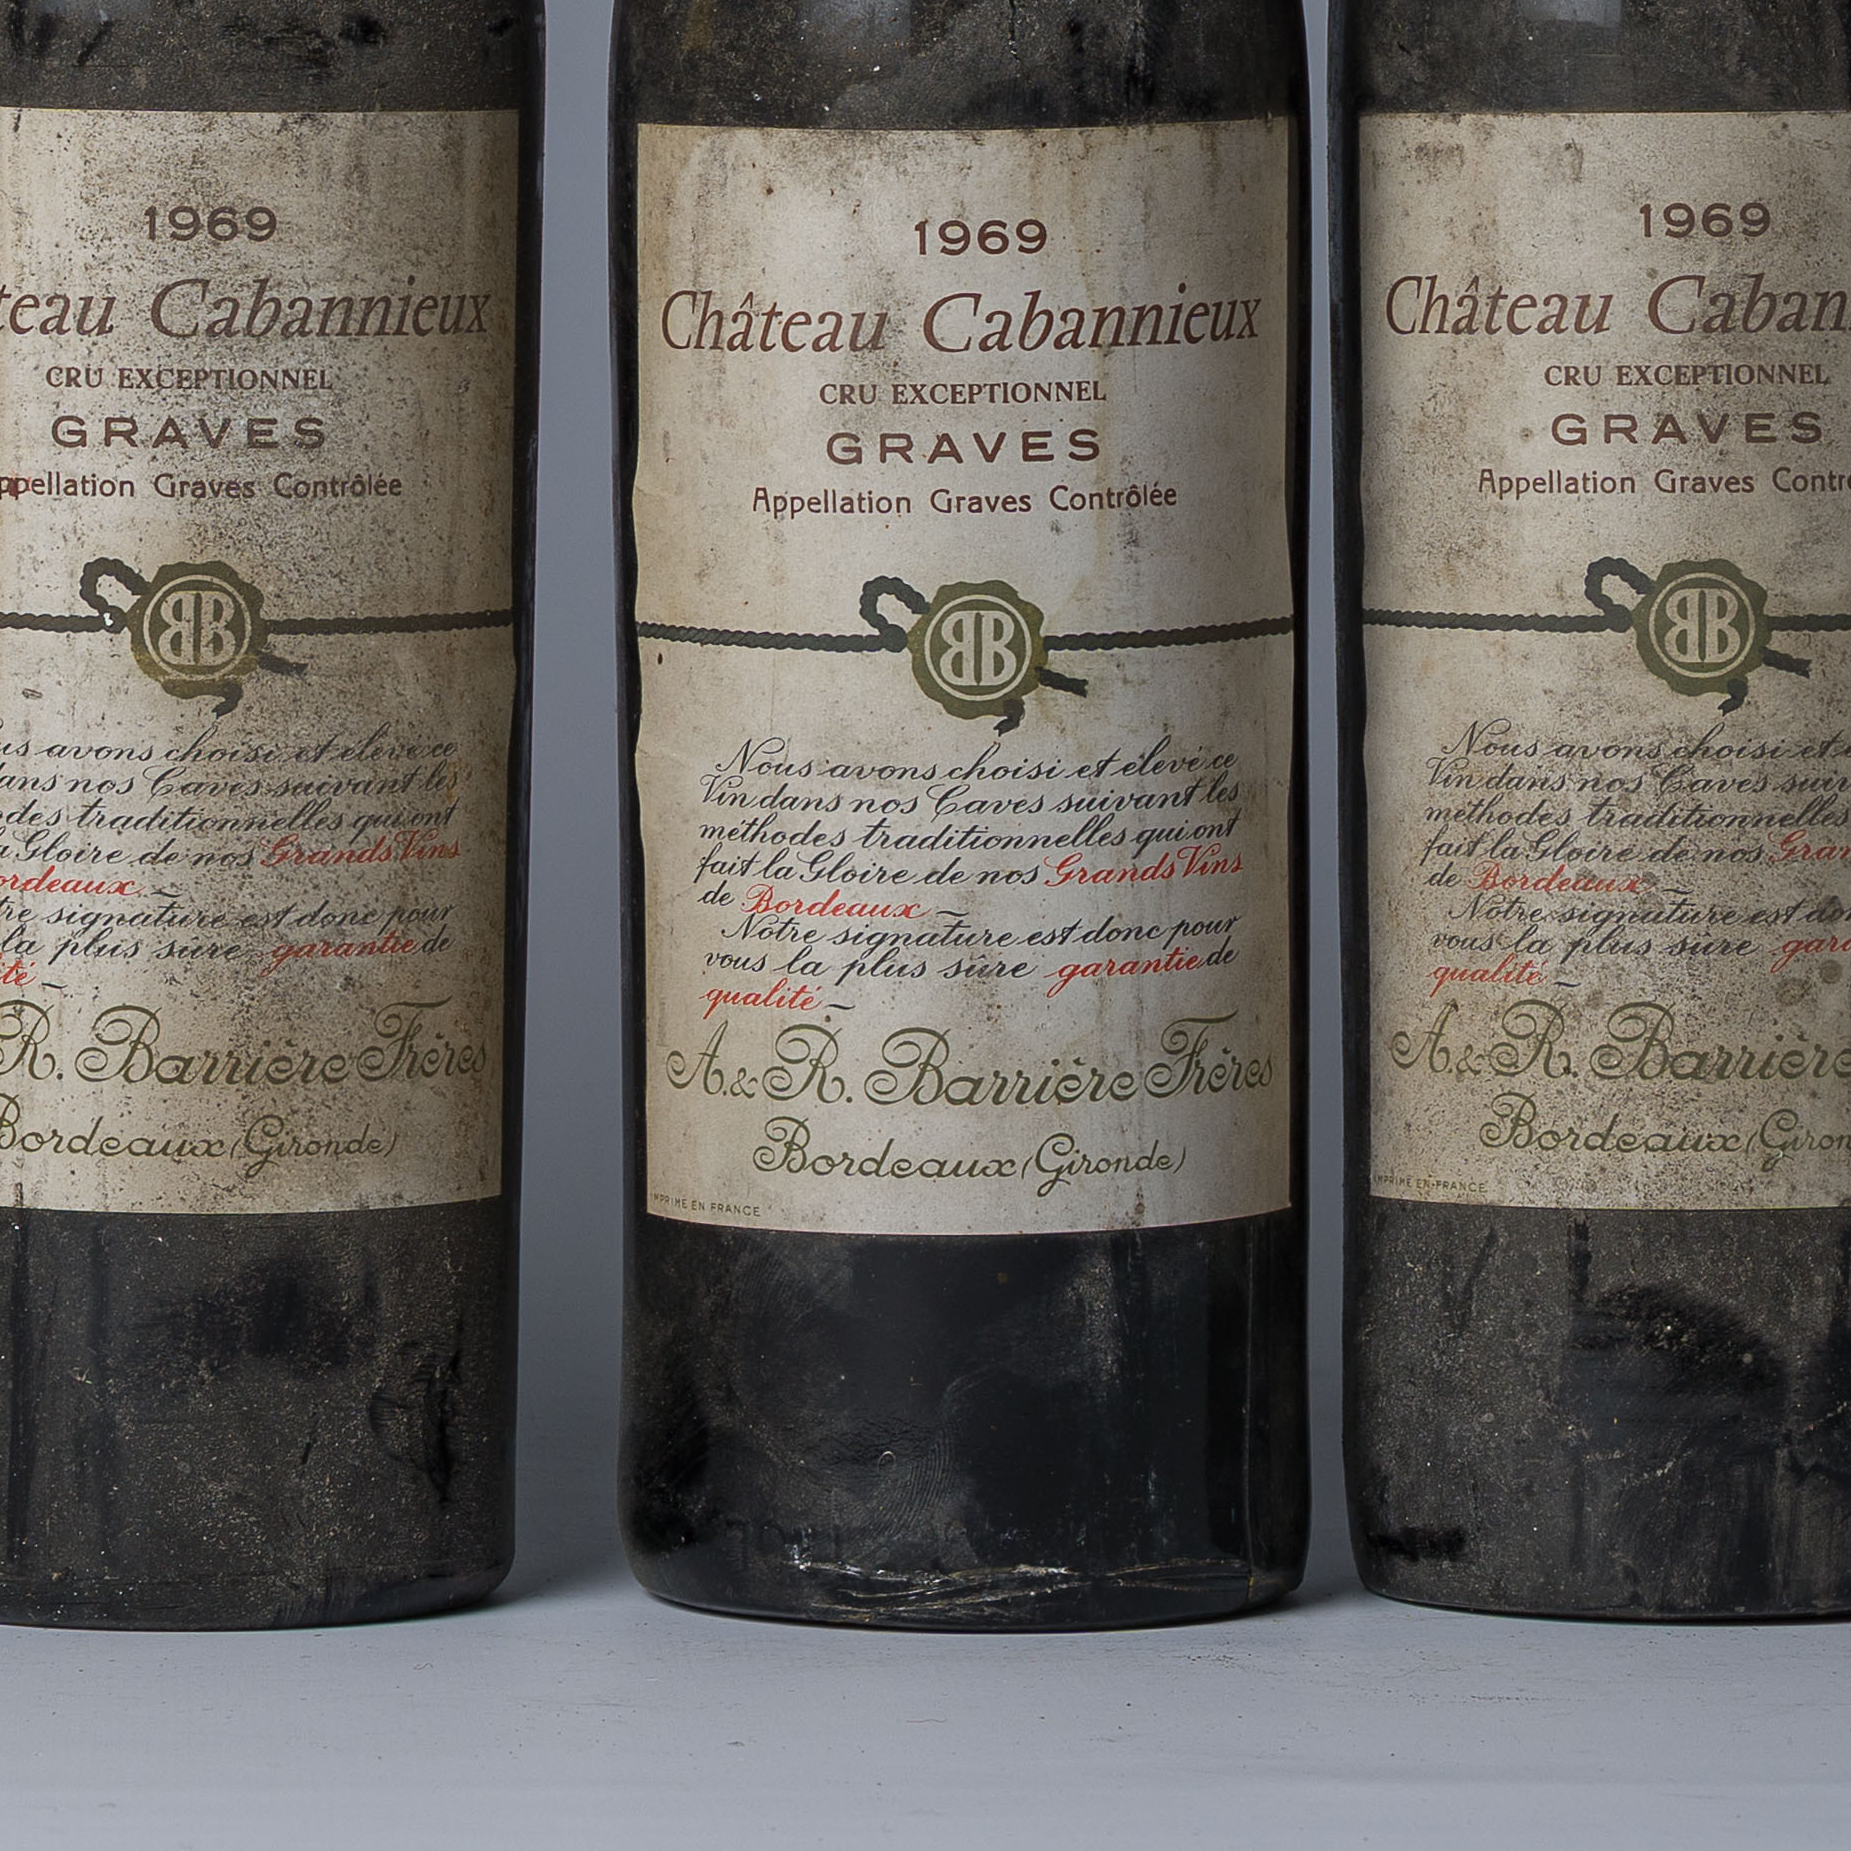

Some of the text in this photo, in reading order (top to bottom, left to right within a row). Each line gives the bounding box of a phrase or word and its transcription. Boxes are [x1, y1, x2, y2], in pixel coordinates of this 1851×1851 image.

[144, 205, 278, 242] 1969
[914, 219, 1048, 256] 1969
[1640, 202, 1771, 239] 1969
[151, 273, 489, 342] Cabannieux
[661, 284, 1261, 353] Château Cabannieux
[1386, 273, 1612, 335] Château
[46, 366, 332, 390] CRU EXCEPTIONNEL
[820, 381, 1106, 405] CRU EXCEPTIONNEL
[1545, 363, 1827, 387] CRU EXCEPTIONNEL
[51, 415, 326, 451] GRAVES
[826, 429, 1101, 465] GRAVES
[1552, 410, 1821, 446] GRAVES
[155, 473, 255, 498] Graves
[273, 472, 403, 500] Contrôlée
[753, 483, 1178, 518] Appellation Graves Contrôlée
[1478, 468, 1636, 498] Appellation
[1656, 468, 1753, 493] Graves
[715, 737, 814, 776] Nous
[817, 763, 937, 780] avons
[940, 741, 1065, 780] choisi
[699, 770, 1239, 823] Vin dans nos Caves suivant les
[852, 813, 1126, 850] traditionnelles
[1129, 819, 1192, 859] qui
[693, 842, 761, 883] fait
[796, 849, 918, 884] Gloire
[913, 857, 972, 885] de
[969, 864, 1040, 885] nos
[1043, 852, 1176, 887] Grands
[1176, 842, 1243, 879] Vins
[697, 879, 932, 920] de Bordeaux
[721, 913, 1241, 959] Notre signature est donc pour
[703, 951, 769, 973] vous
[835, 947, 928, 986] plus
[1043, 946, 1205, 999] garantie
[1198, 935, 1239, 967] de
[698, 977, 822, 1020] qualité
[1478, 1090, 1743, 1154] Bordeaux
[752, 1115, 1017, 1179] Bordeaux
[691, 1200, 705, 1211] EN
[710, 1202, 761, 1217] FRANCE
